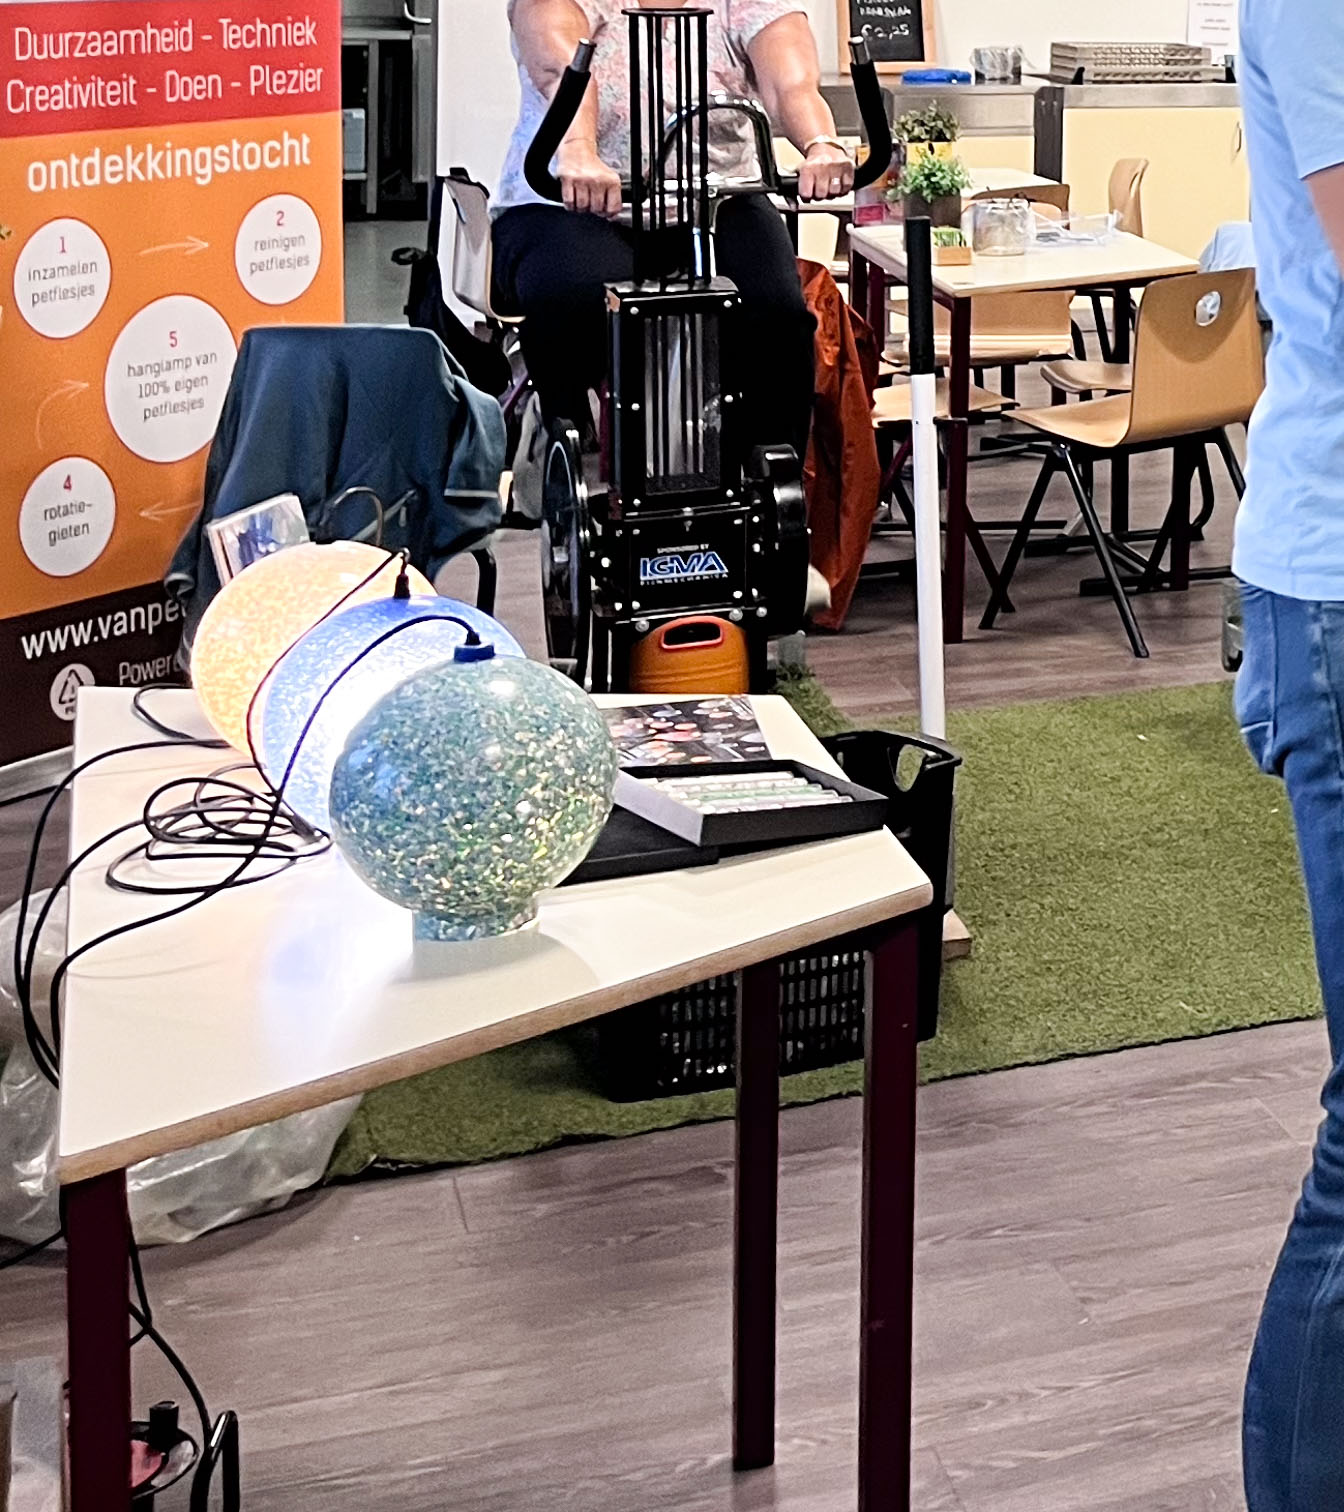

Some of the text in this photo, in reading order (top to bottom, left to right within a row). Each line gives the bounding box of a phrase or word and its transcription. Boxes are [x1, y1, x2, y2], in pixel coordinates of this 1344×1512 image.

[15, 19, 193, 61] Duurzaamheid
[219, 16, 318, 50] Techniek
[6, 74, 137, 114] Creativiteit
[165, 70, 222, 103] Doen
[250, 63, 323, 96] Plezier
[27, 130, 311, 193] ontdekkingstocht
[276, 210, 285, 226] 2
[58, 235, 67, 254] 1
[254, 235, 306, 252] reinigen
[28, 261, 97, 282] inzamelen
[249, 255, 310, 276] petflesjes
[32, 284, 95, 308] petflesjes
[169, 330, 178, 348] 5
[127, 352, 217, 378] hanglamp van
[138, 375, 208, 399] 100% eigen
[143, 397, 205, 423] petflesjes
[63, 474, 72, 491] 4
[48, 523, 90, 547] gieten
